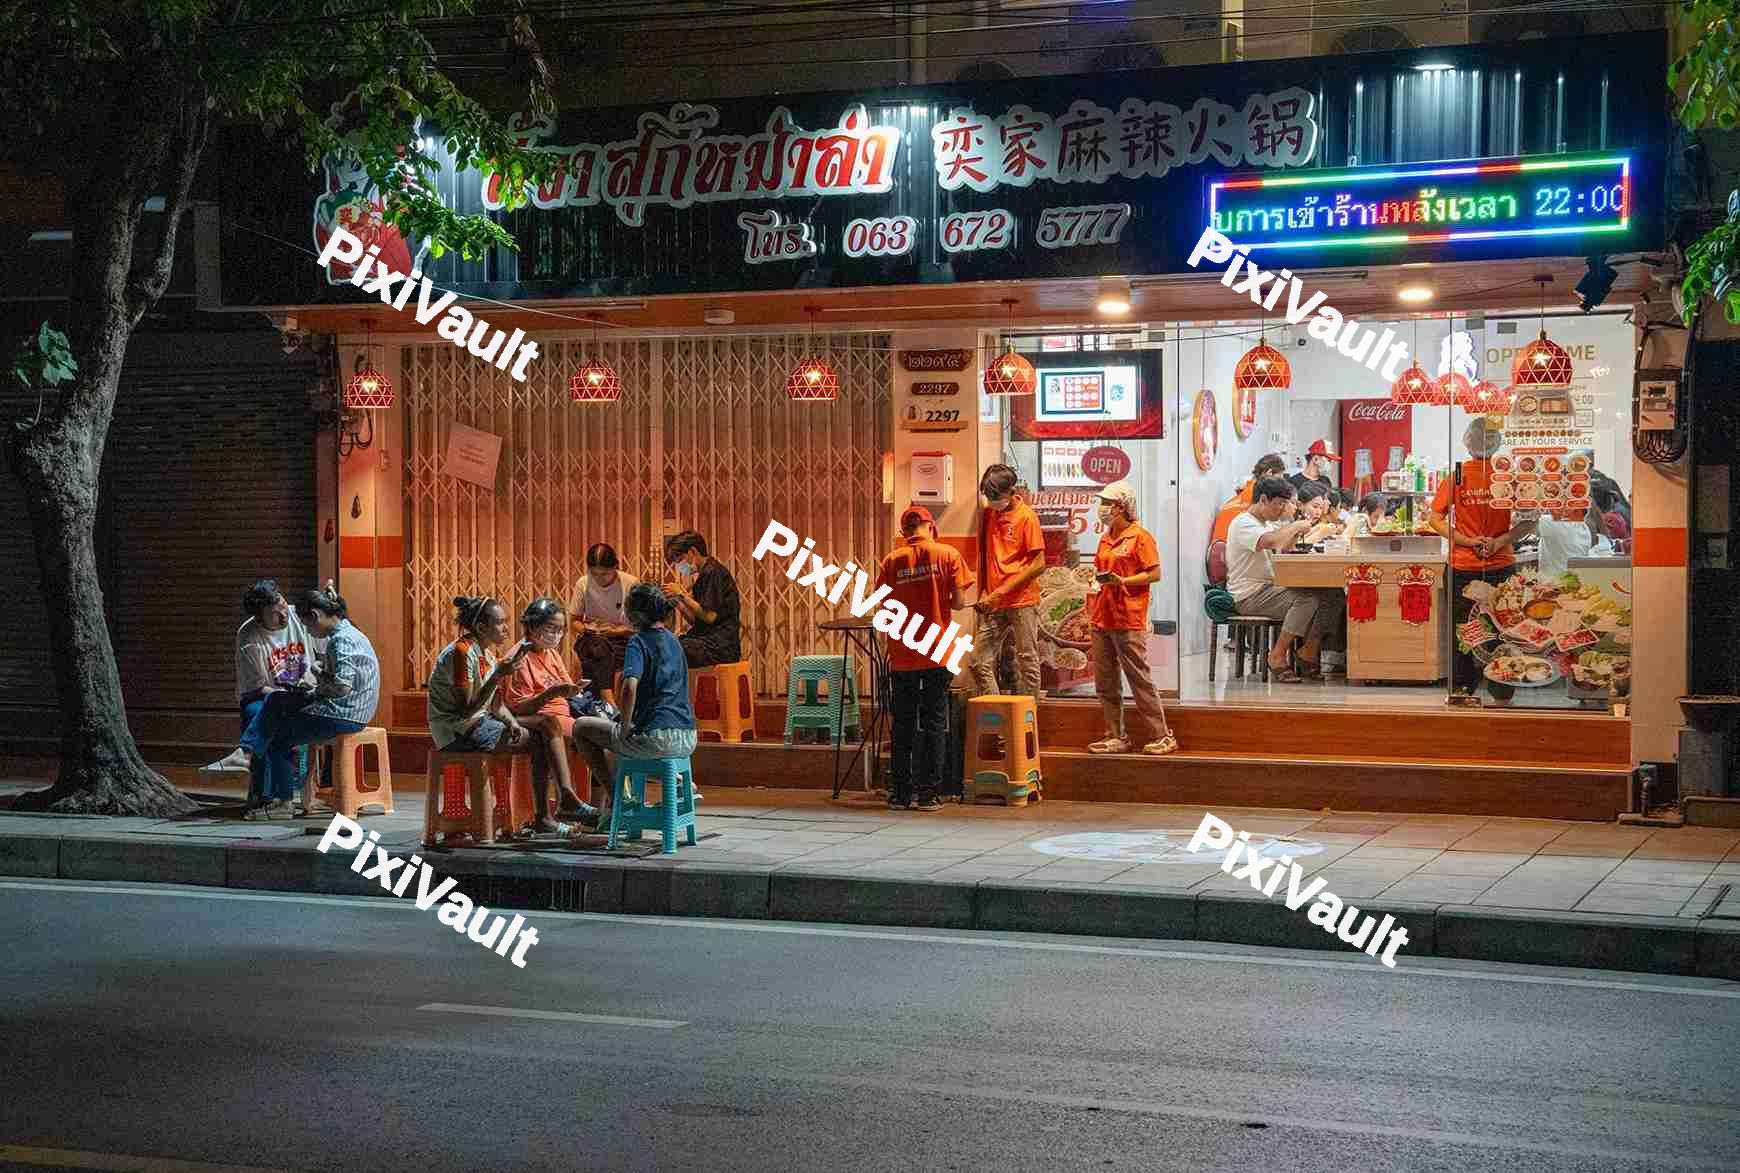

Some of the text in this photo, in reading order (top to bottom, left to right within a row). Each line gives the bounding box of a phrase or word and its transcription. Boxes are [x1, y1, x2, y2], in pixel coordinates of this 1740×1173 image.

[941, 99, 1303, 181] 奕家麻辣火锅
[848, 220, 909, 251] 063
[943, 213, 1006, 245] 672
[1041, 207, 1122, 243] 5777
[926, 409, 960, 422] 2297
[1533, 437, 1557, 446] YOUR
[1558, 436, 1593, 446] SERVICE
[1090, 457, 1121, 474] OPEN
